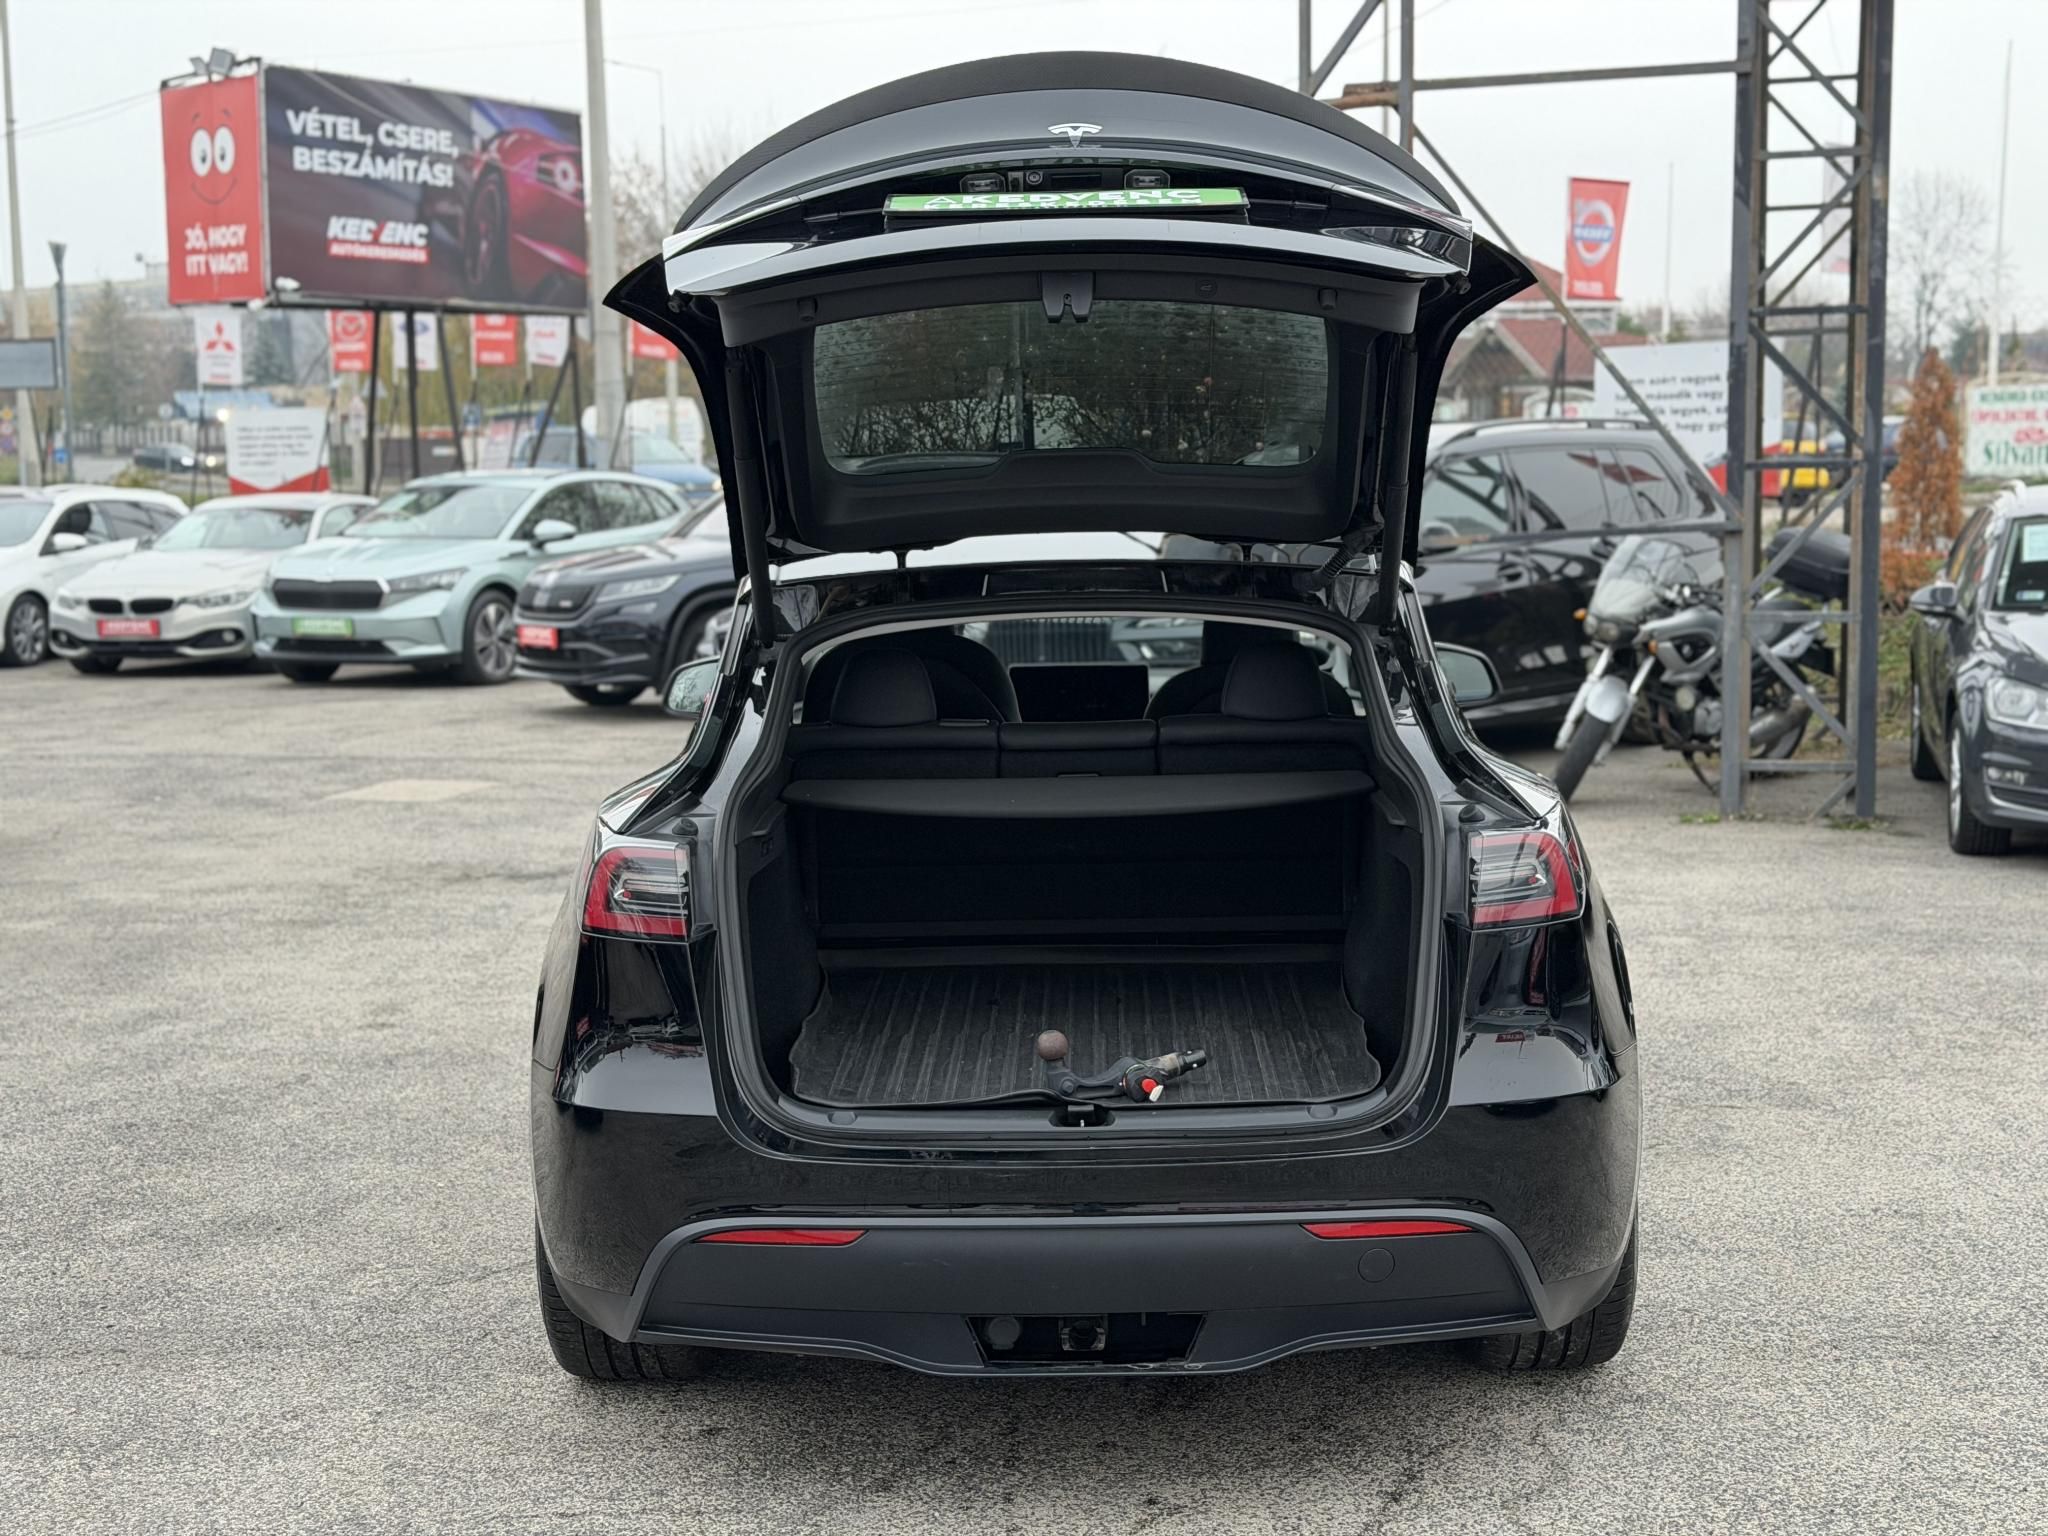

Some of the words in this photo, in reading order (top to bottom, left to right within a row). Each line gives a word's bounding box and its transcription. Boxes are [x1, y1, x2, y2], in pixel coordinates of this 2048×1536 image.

[286, 106, 374, 147] VÉTEL,
[377, 122, 459, 159] CSERE,
[293, 145, 454, 188] BESZÁMÍTÁS!
[962, 189, 1201, 204] KEDVENC
